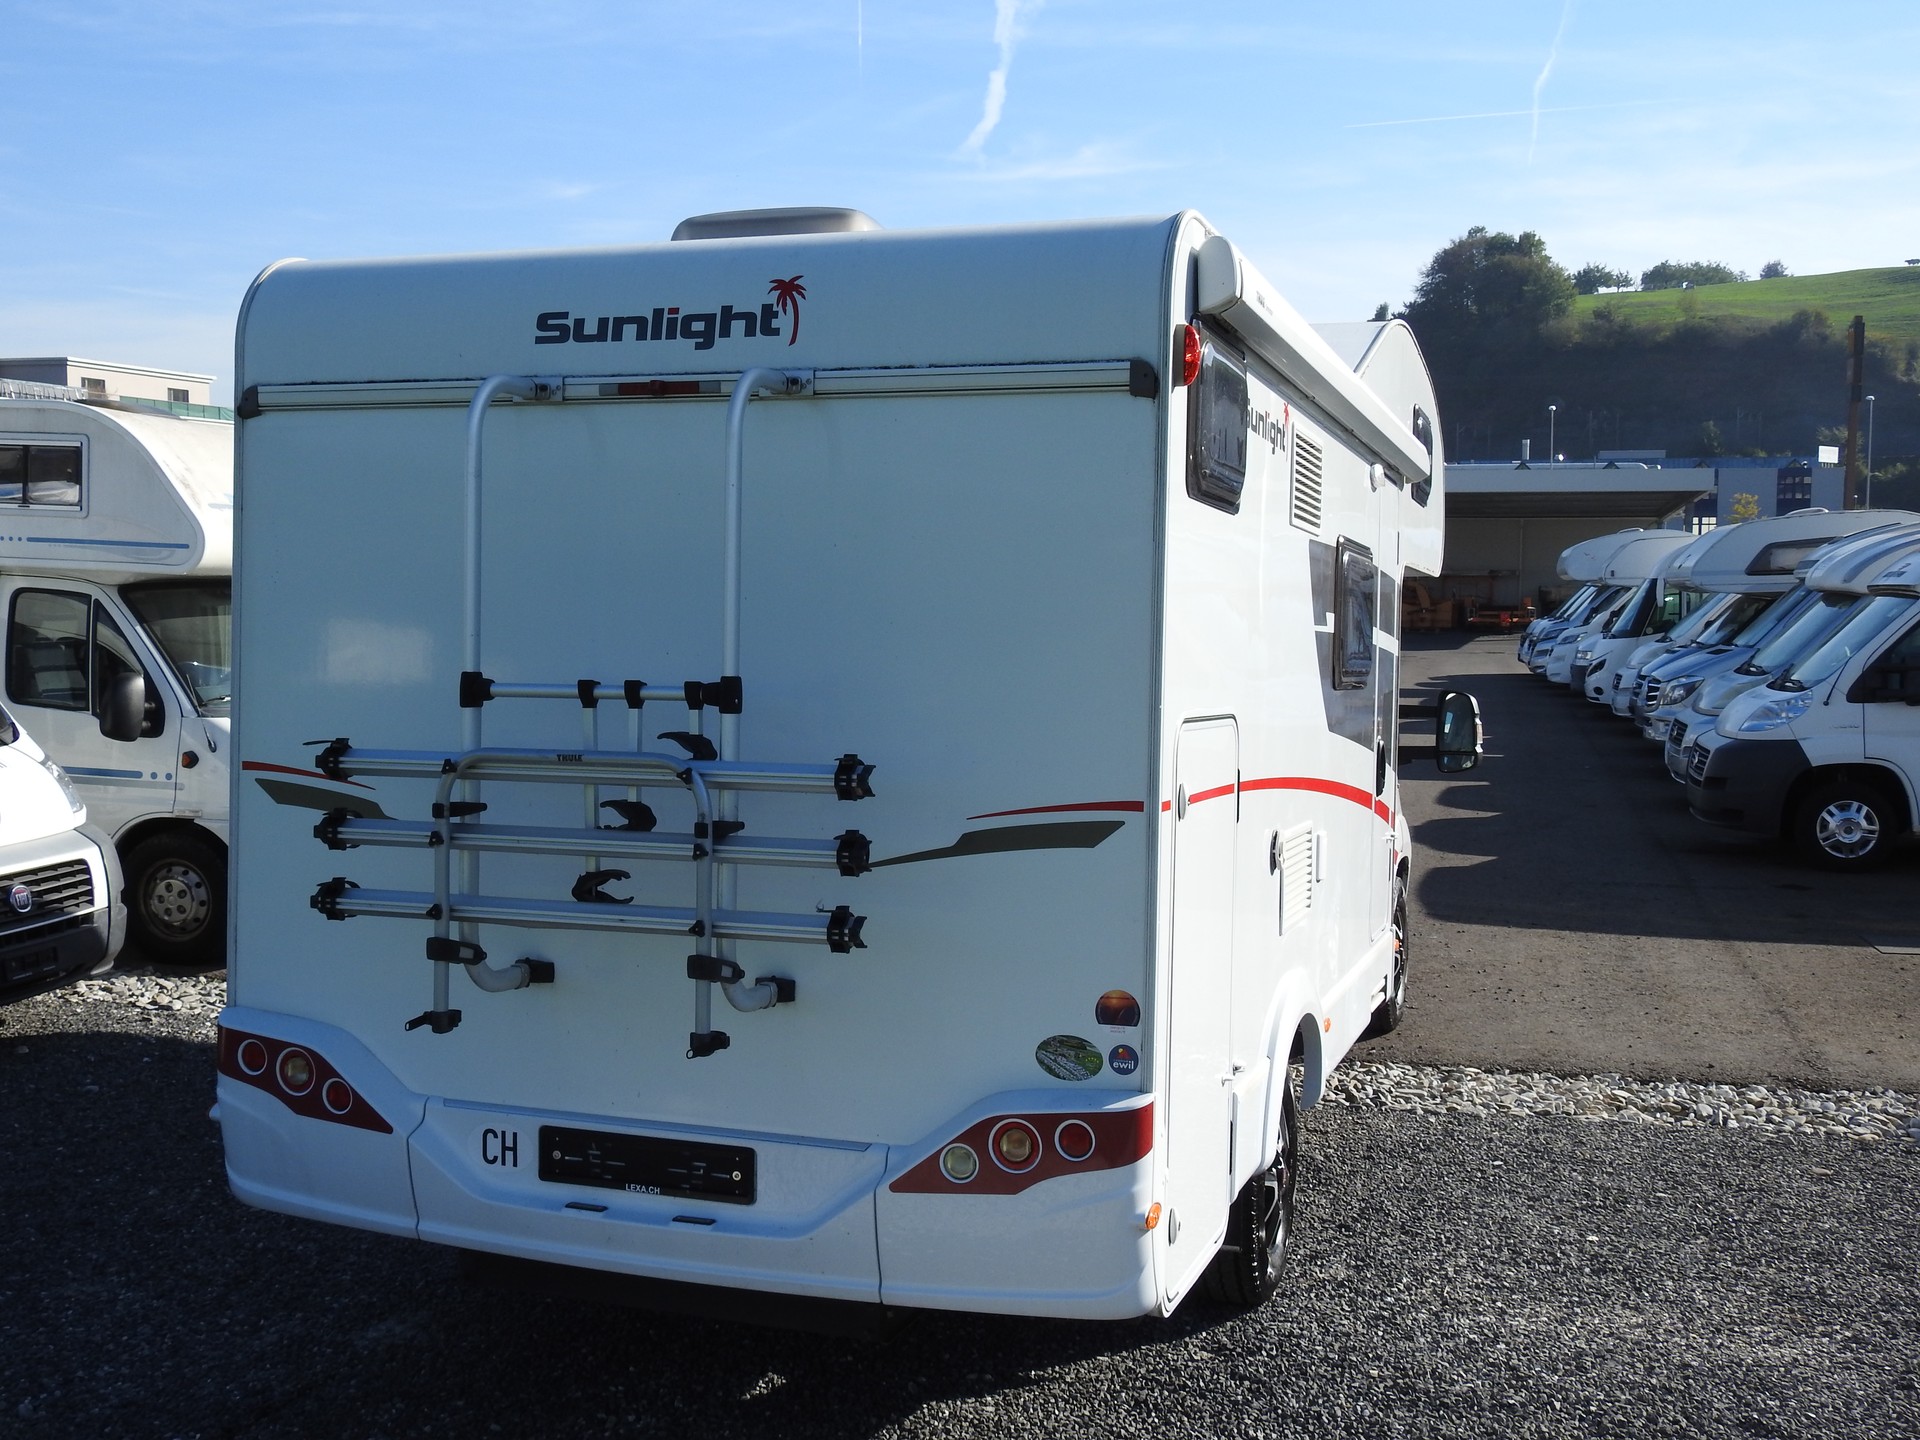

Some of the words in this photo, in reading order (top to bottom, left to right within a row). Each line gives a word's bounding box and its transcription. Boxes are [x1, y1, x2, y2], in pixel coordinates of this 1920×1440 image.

[534, 303, 780, 350] Sunlight
[556, 753, 583, 762] THULE
[1113, 1061, 1134, 1070] ewil
[482, 1128, 518, 1168] CH
[626, 1184, 660, 1195] LEXA.CH
